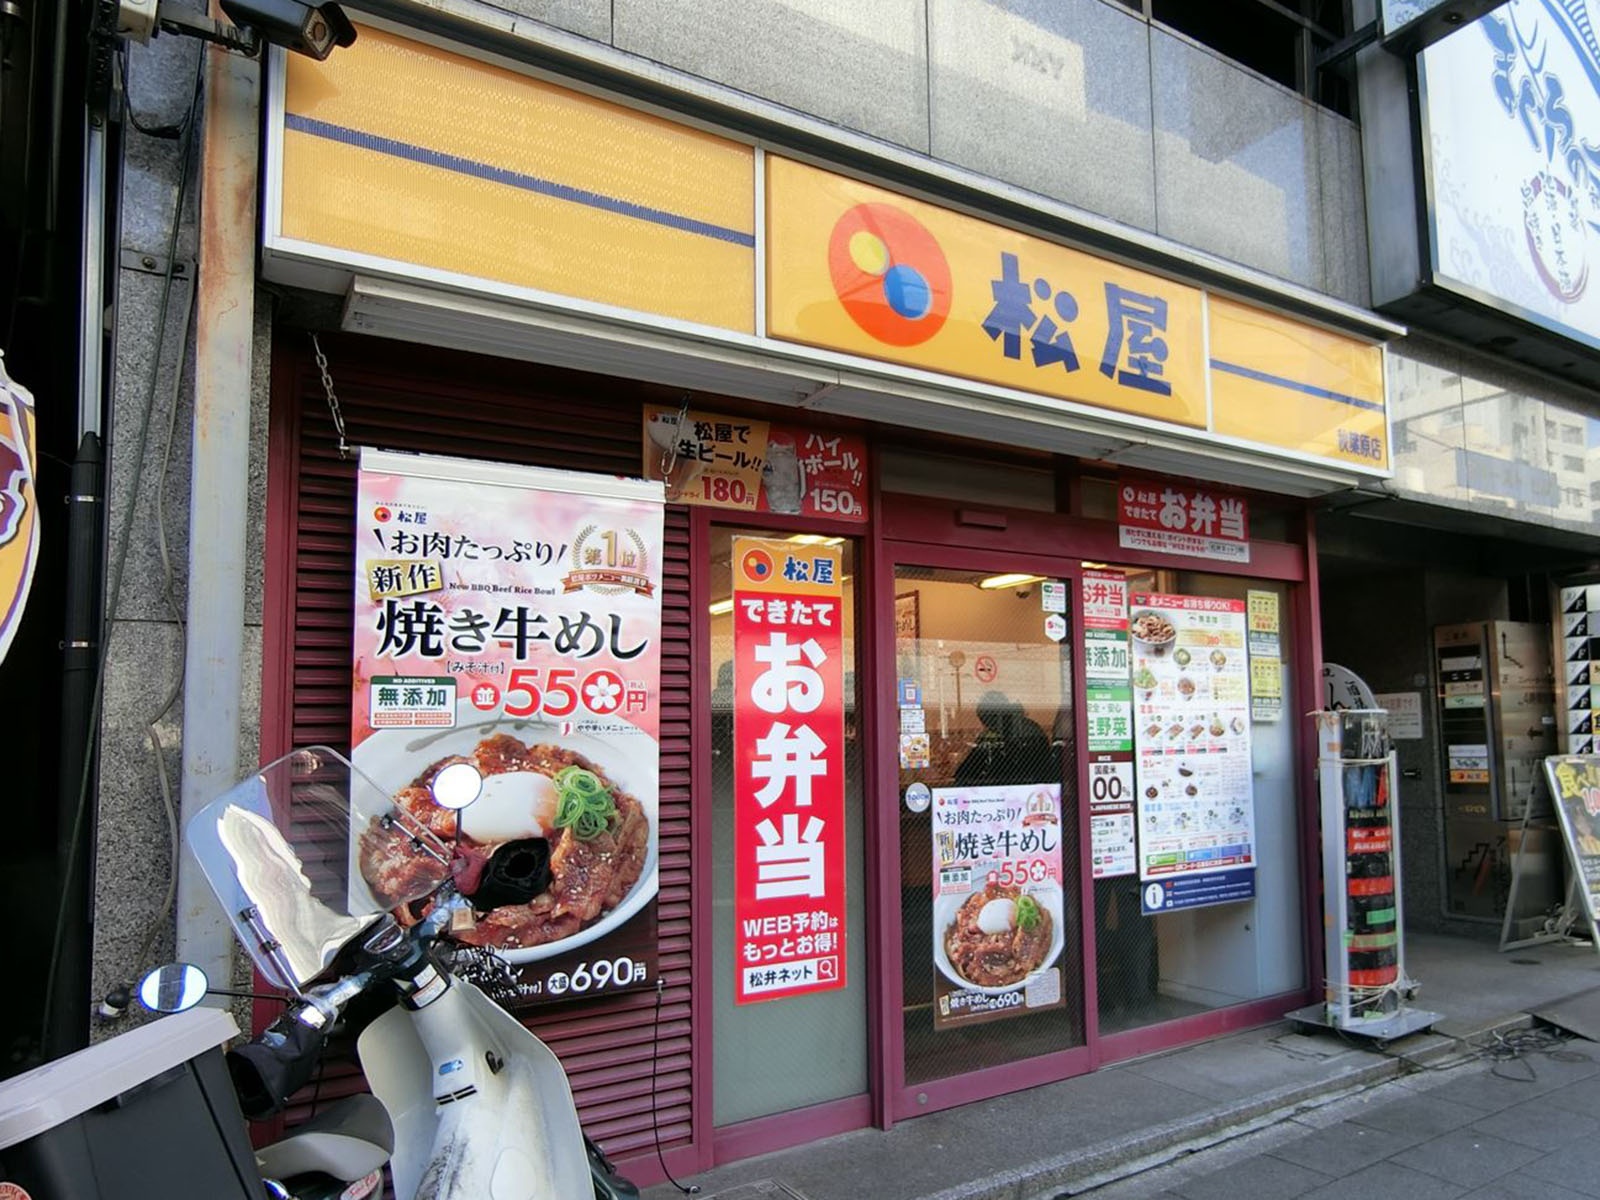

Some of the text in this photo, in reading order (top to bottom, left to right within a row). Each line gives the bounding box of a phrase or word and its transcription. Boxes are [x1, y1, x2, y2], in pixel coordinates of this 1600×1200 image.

[981, 251, 1173, 397] 松屋
[694, 421, 751, 443] 松屋で
[805, 433, 841, 457] ハイ
[702, 476, 755, 505] 180円
[811, 489, 863, 516] 150円
[397, 510, 427, 525] 松屋
[1124, 506, 1157, 520] できたて
[1160, 487, 1244, 539] お弁当
[372, 562, 437, 594] 新作
[783, 556, 834, 584] 松屋
[449, 582, 556, 595] New BBQ Beef Rice Bowl
[741, 599, 834, 626] できたて
[376, 600, 648, 661] 焼き牛めし
[378, 686, 447, 706] 無添加
[750, 632, 828, 900] お弁当
[955, 829, 1057, 860] 焼き牛めし
[743, 911, 838, 936] WEB予約は
[743, 932, 838, 961] もっとお得!
[570, 956, 647, 992] 690円
[749, 967, 813, 988] 松弁ネット
